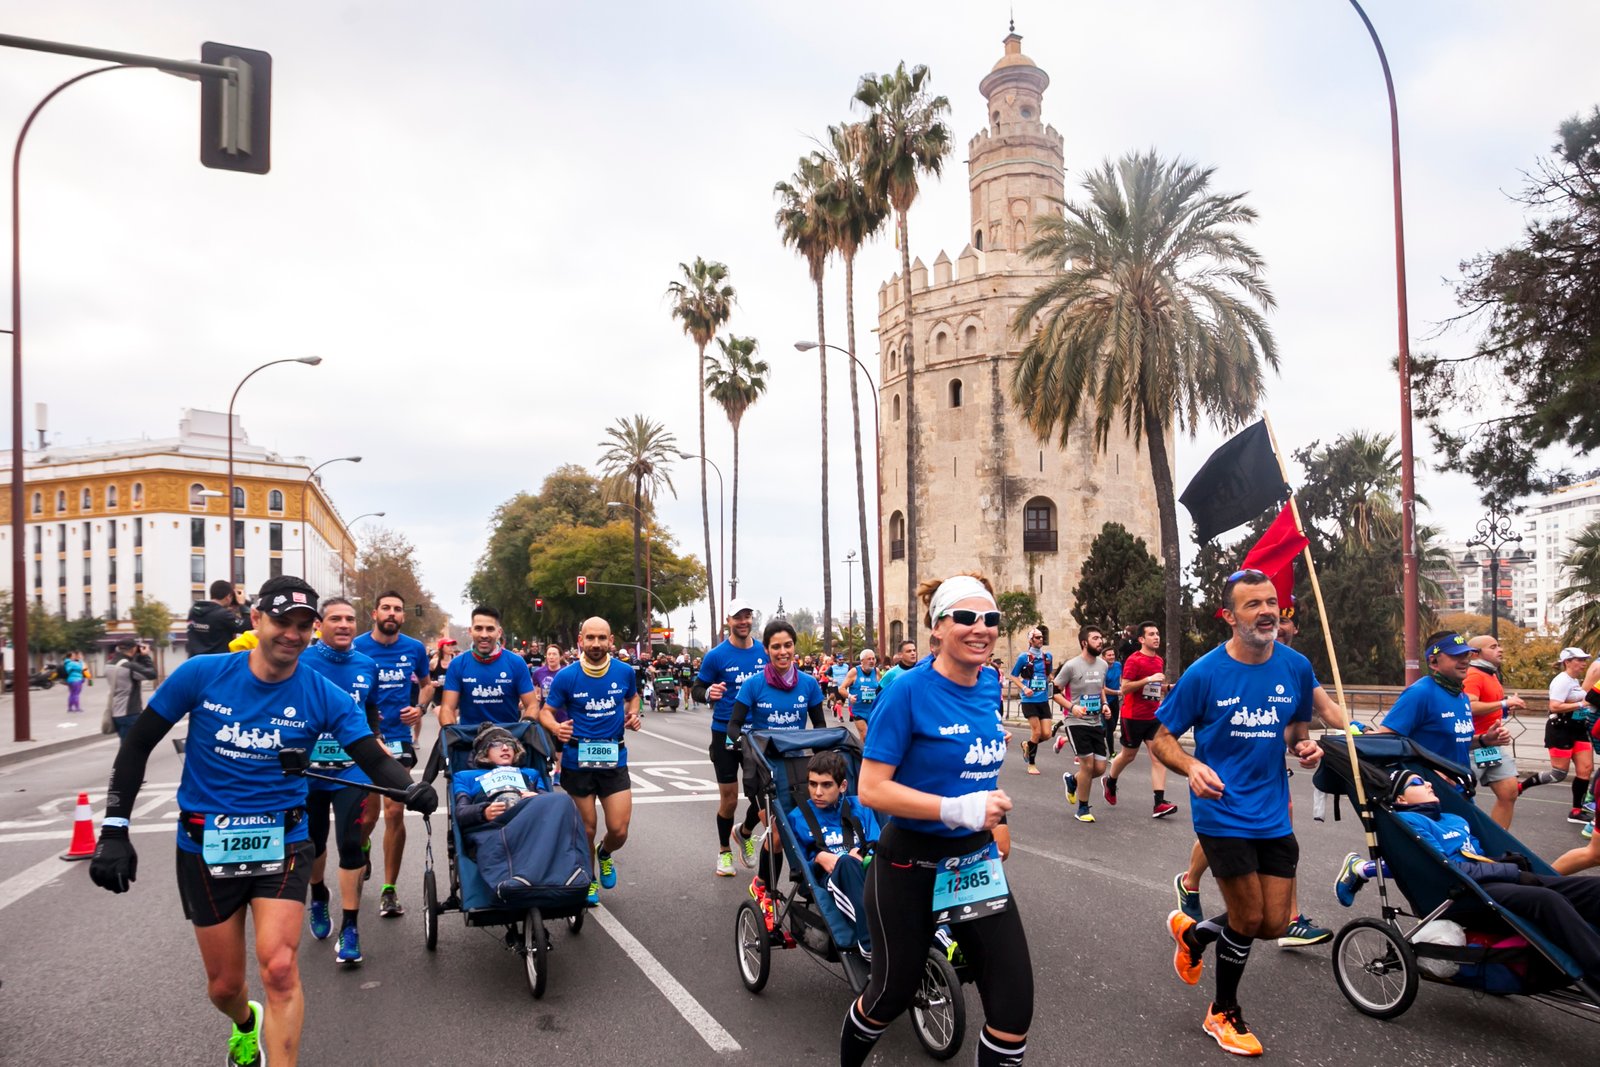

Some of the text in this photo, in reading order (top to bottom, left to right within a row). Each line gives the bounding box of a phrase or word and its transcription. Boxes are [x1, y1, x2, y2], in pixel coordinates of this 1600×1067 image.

[1217, 696, 1240, 706] aefat
[1268, 695, 1292, 703] ZURICH
[203, 700, 232, 716] aefat
[270, 717, 305, 728] ZURICH
[939, 723, 970, 735] aefat
[317, 746, 341, 755] 1267
[587, 747, 612, 755] 12806
[232, 815, 277, 826] ZURICH
[221, 836, 272, 852] 12807
[961, 847, 990, 867] ZURICH
[947, 870, 990, 894] 12385
